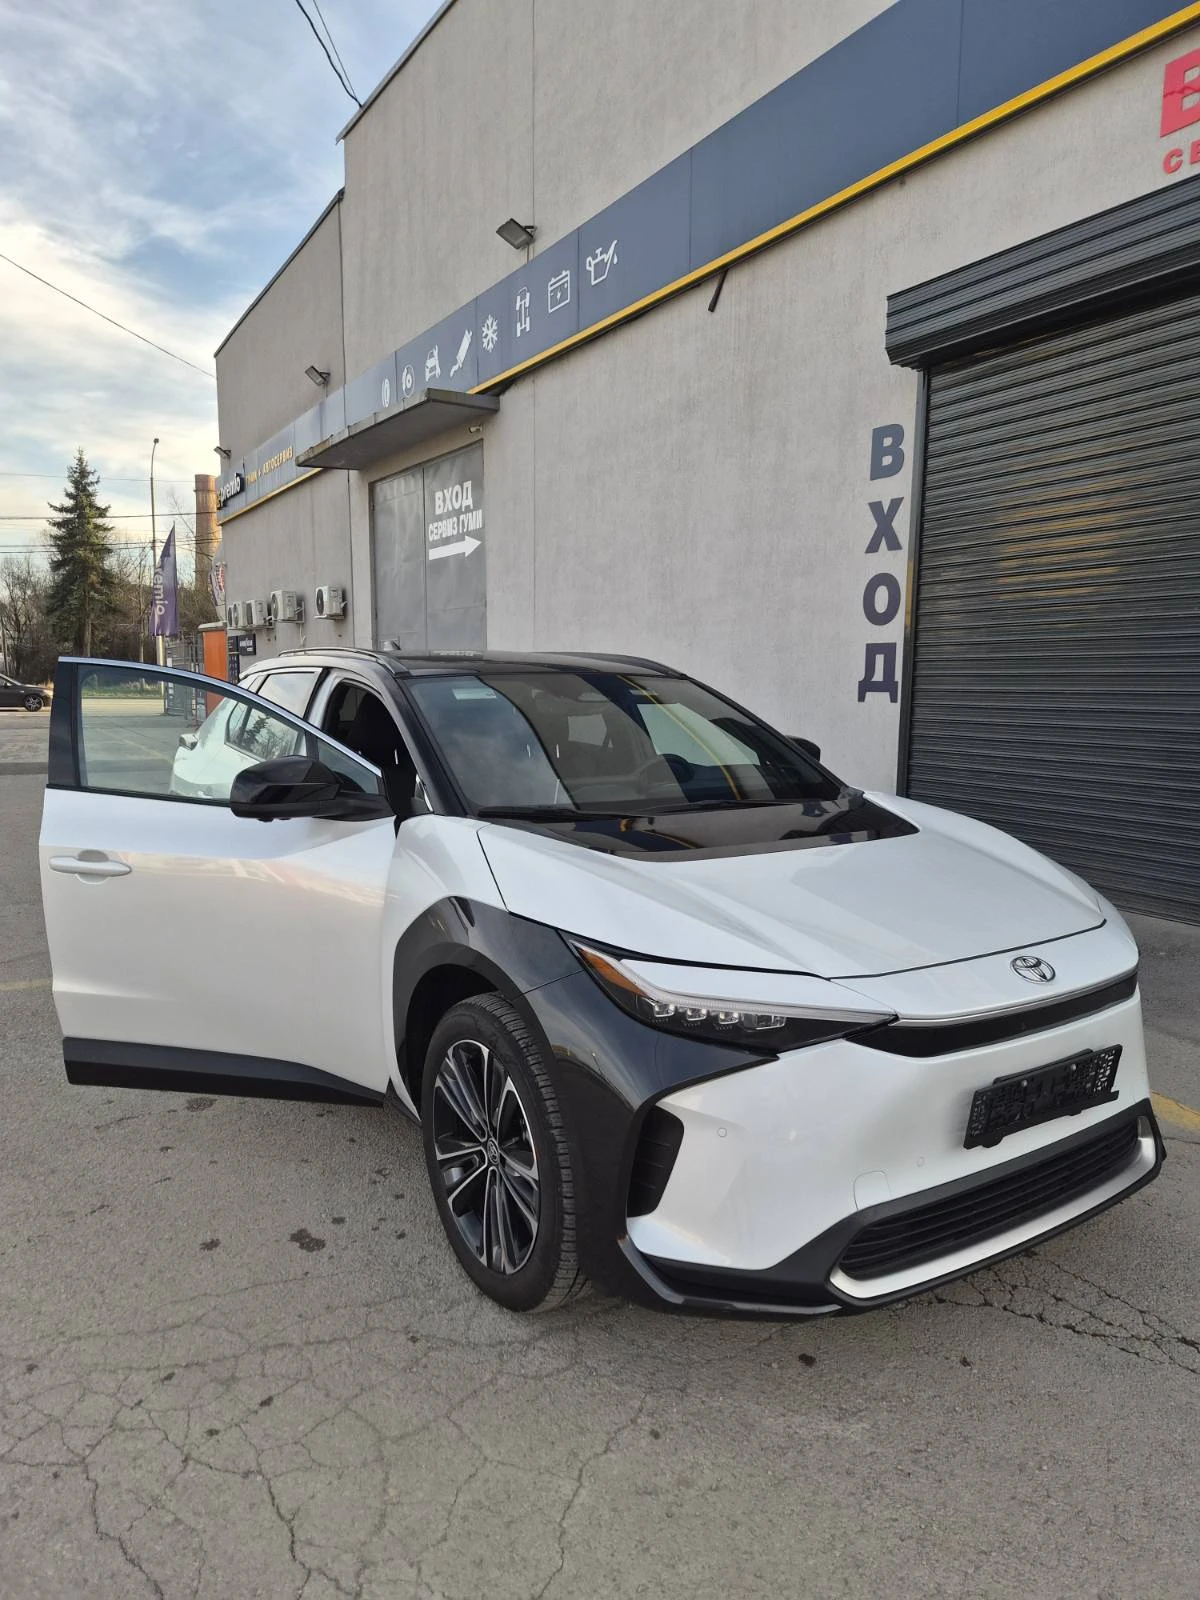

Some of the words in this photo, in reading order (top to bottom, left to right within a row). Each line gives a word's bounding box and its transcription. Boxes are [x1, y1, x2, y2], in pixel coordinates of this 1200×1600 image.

[435, 480, 473, 515] ВХОД
[428, 516, 458, 542] СЕРВИЗ
[459, 509, 483, 534] ГУМИ
[857, 423, 905, 704] ВХОД
